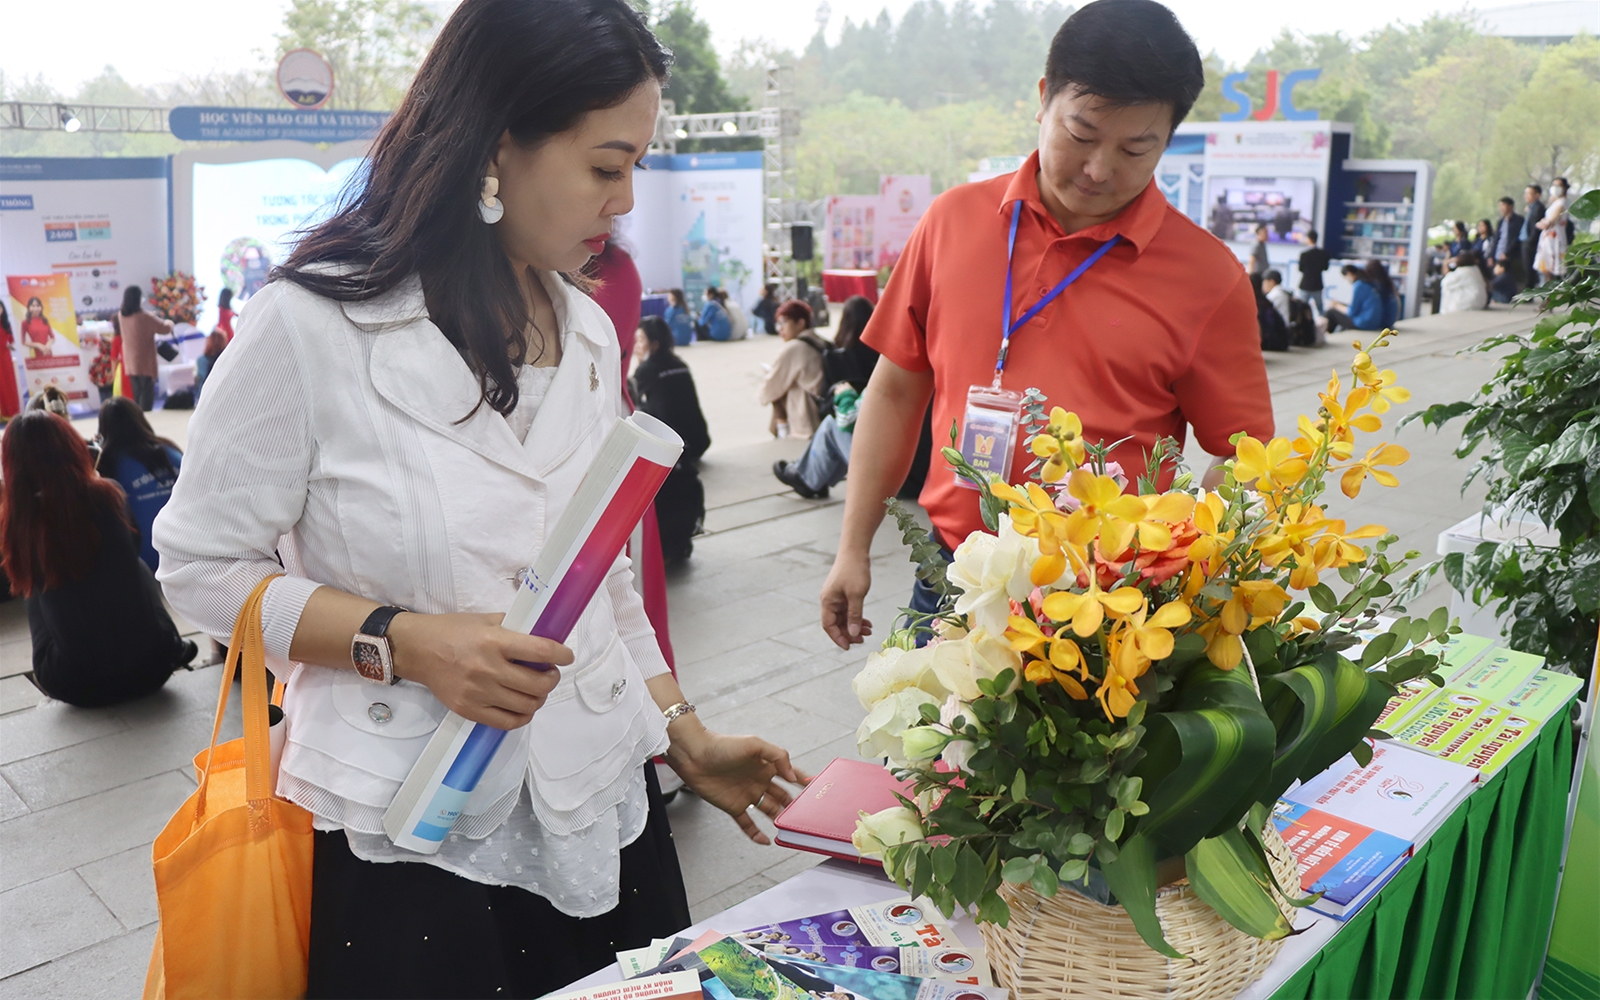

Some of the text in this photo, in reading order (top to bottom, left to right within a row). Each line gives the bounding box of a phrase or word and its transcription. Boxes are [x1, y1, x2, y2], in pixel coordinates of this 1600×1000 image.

[1219, 68, 1323, 122] SJC
[200, 112, 229, 126] HỌC
[232, 110, 263, 126] VIỆN
[266, 111, 292, 125] BÁO
[295, 111, 318, 125] CHÍ
[321, 111, 337, 126] VÀ
[201, 128, 221, 137] THE
[222, 128, 266, 137] ACADEMY
[267, 128, 279, 137] OF
[50, 230, 73, 239] 2400
[973, 458, 990, 469] BAN
[1399, 686, 1422, 702] Tài
[1421, 705, 1448, 722] Môi
[1413, 705, 1474, 748] Tài nguyên
[1468, 715, 1495, 731] Tài
[1461, 726, 1524, 770] Tài nguyên
[1329, 829, 1351, 842] KINH
[1323, 839, 1344, 849] TẾ
[1312, 844, 1339, 858] BIỂN
[1298, 853, 1324, 866] VIỆT
[890, 931, 905, 942] và
[916, 923, 951, 948] Tà
[653, 979, 673, 989] NHẬN
[664, 986, 673, 994] BỘ
[593, 988, 621, 999] CHƯƠNG
